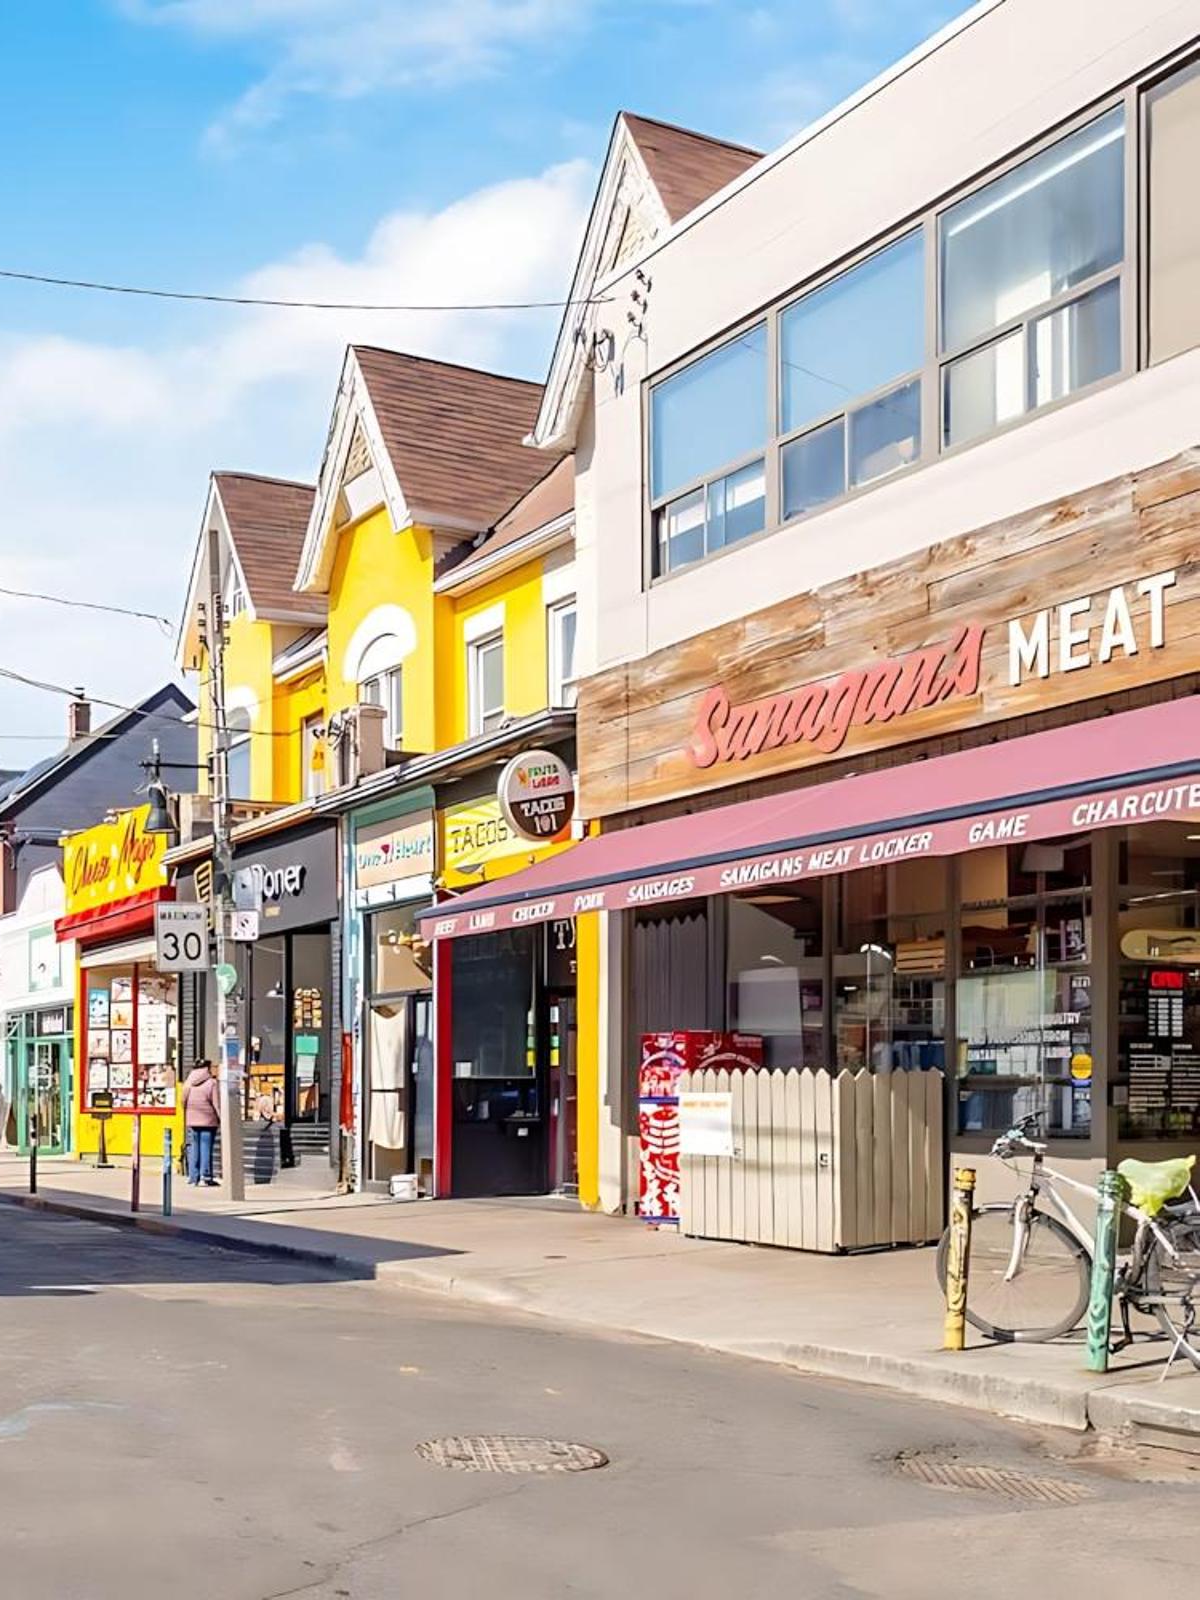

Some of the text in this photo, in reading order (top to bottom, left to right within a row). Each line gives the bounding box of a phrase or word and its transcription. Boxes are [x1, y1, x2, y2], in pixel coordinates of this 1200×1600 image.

[686, 571, 1177, 769] Sanagan's MEAT
[520, 796, 565, 817] TACOS
[451, 817, 508, 853] TACOS
[626, 876, 696, 903] SAUSAGES
[719, 858, 803, 888] SANAGANS
[807, 846, 853, 872] MEAT
[859, 831, 934, 864] LOCKER
[968, 813, 1031, 844] GAME
[163, 932, 202, 961] 30
